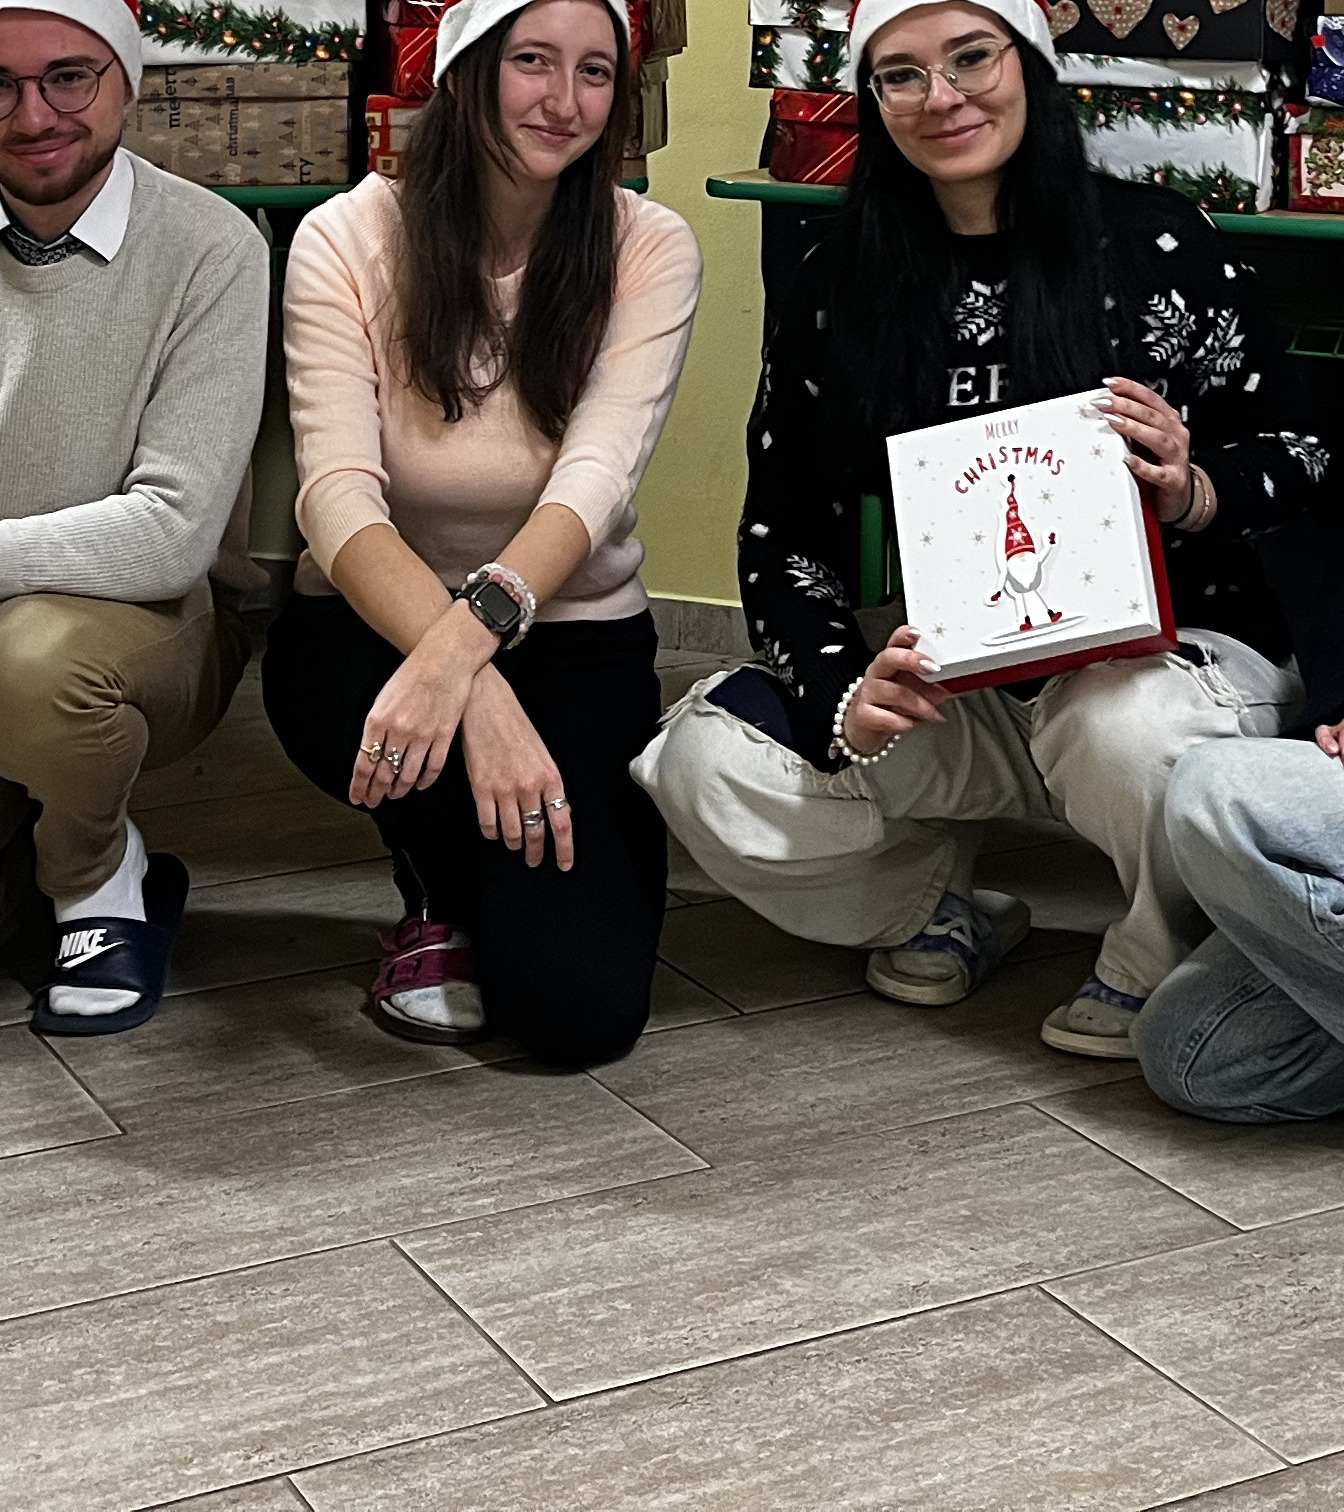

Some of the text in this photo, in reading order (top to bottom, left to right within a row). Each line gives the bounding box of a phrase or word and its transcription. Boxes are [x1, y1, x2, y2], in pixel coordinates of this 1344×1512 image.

[984, 419, 1020, 440] MERRY
[955, 445, 1065, 494] CHRISTMAS
[58, 928, 108, 960] NIKE
